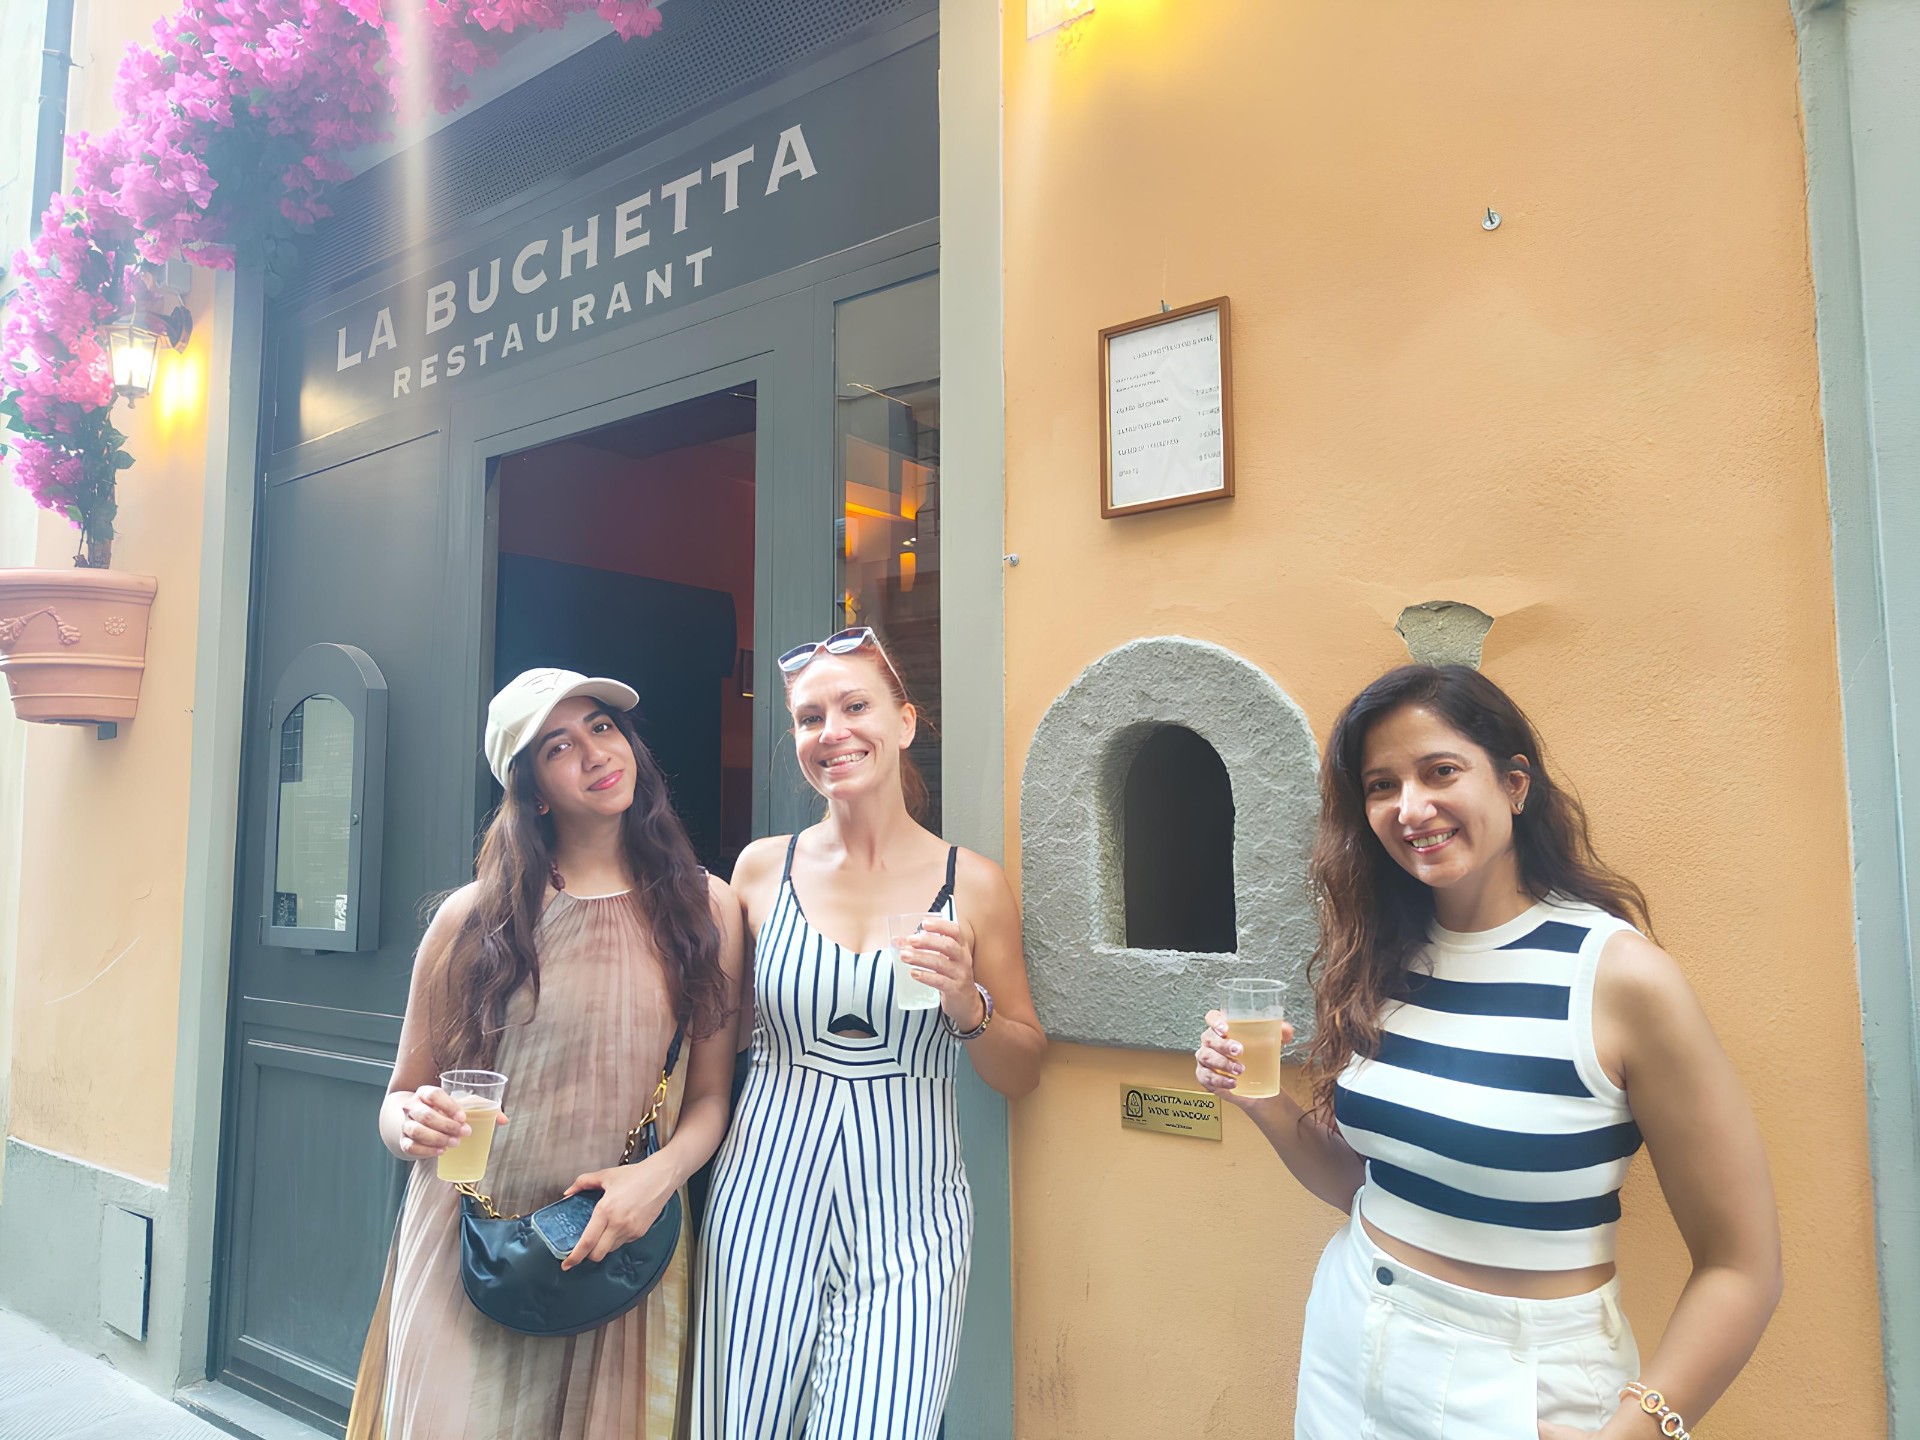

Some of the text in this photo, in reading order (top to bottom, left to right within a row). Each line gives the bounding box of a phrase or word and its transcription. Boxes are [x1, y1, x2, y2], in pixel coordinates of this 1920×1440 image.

[336, 123, 818, 372] LA BUCHETTA
[393, 246, 713, 399] RESTAURANT
